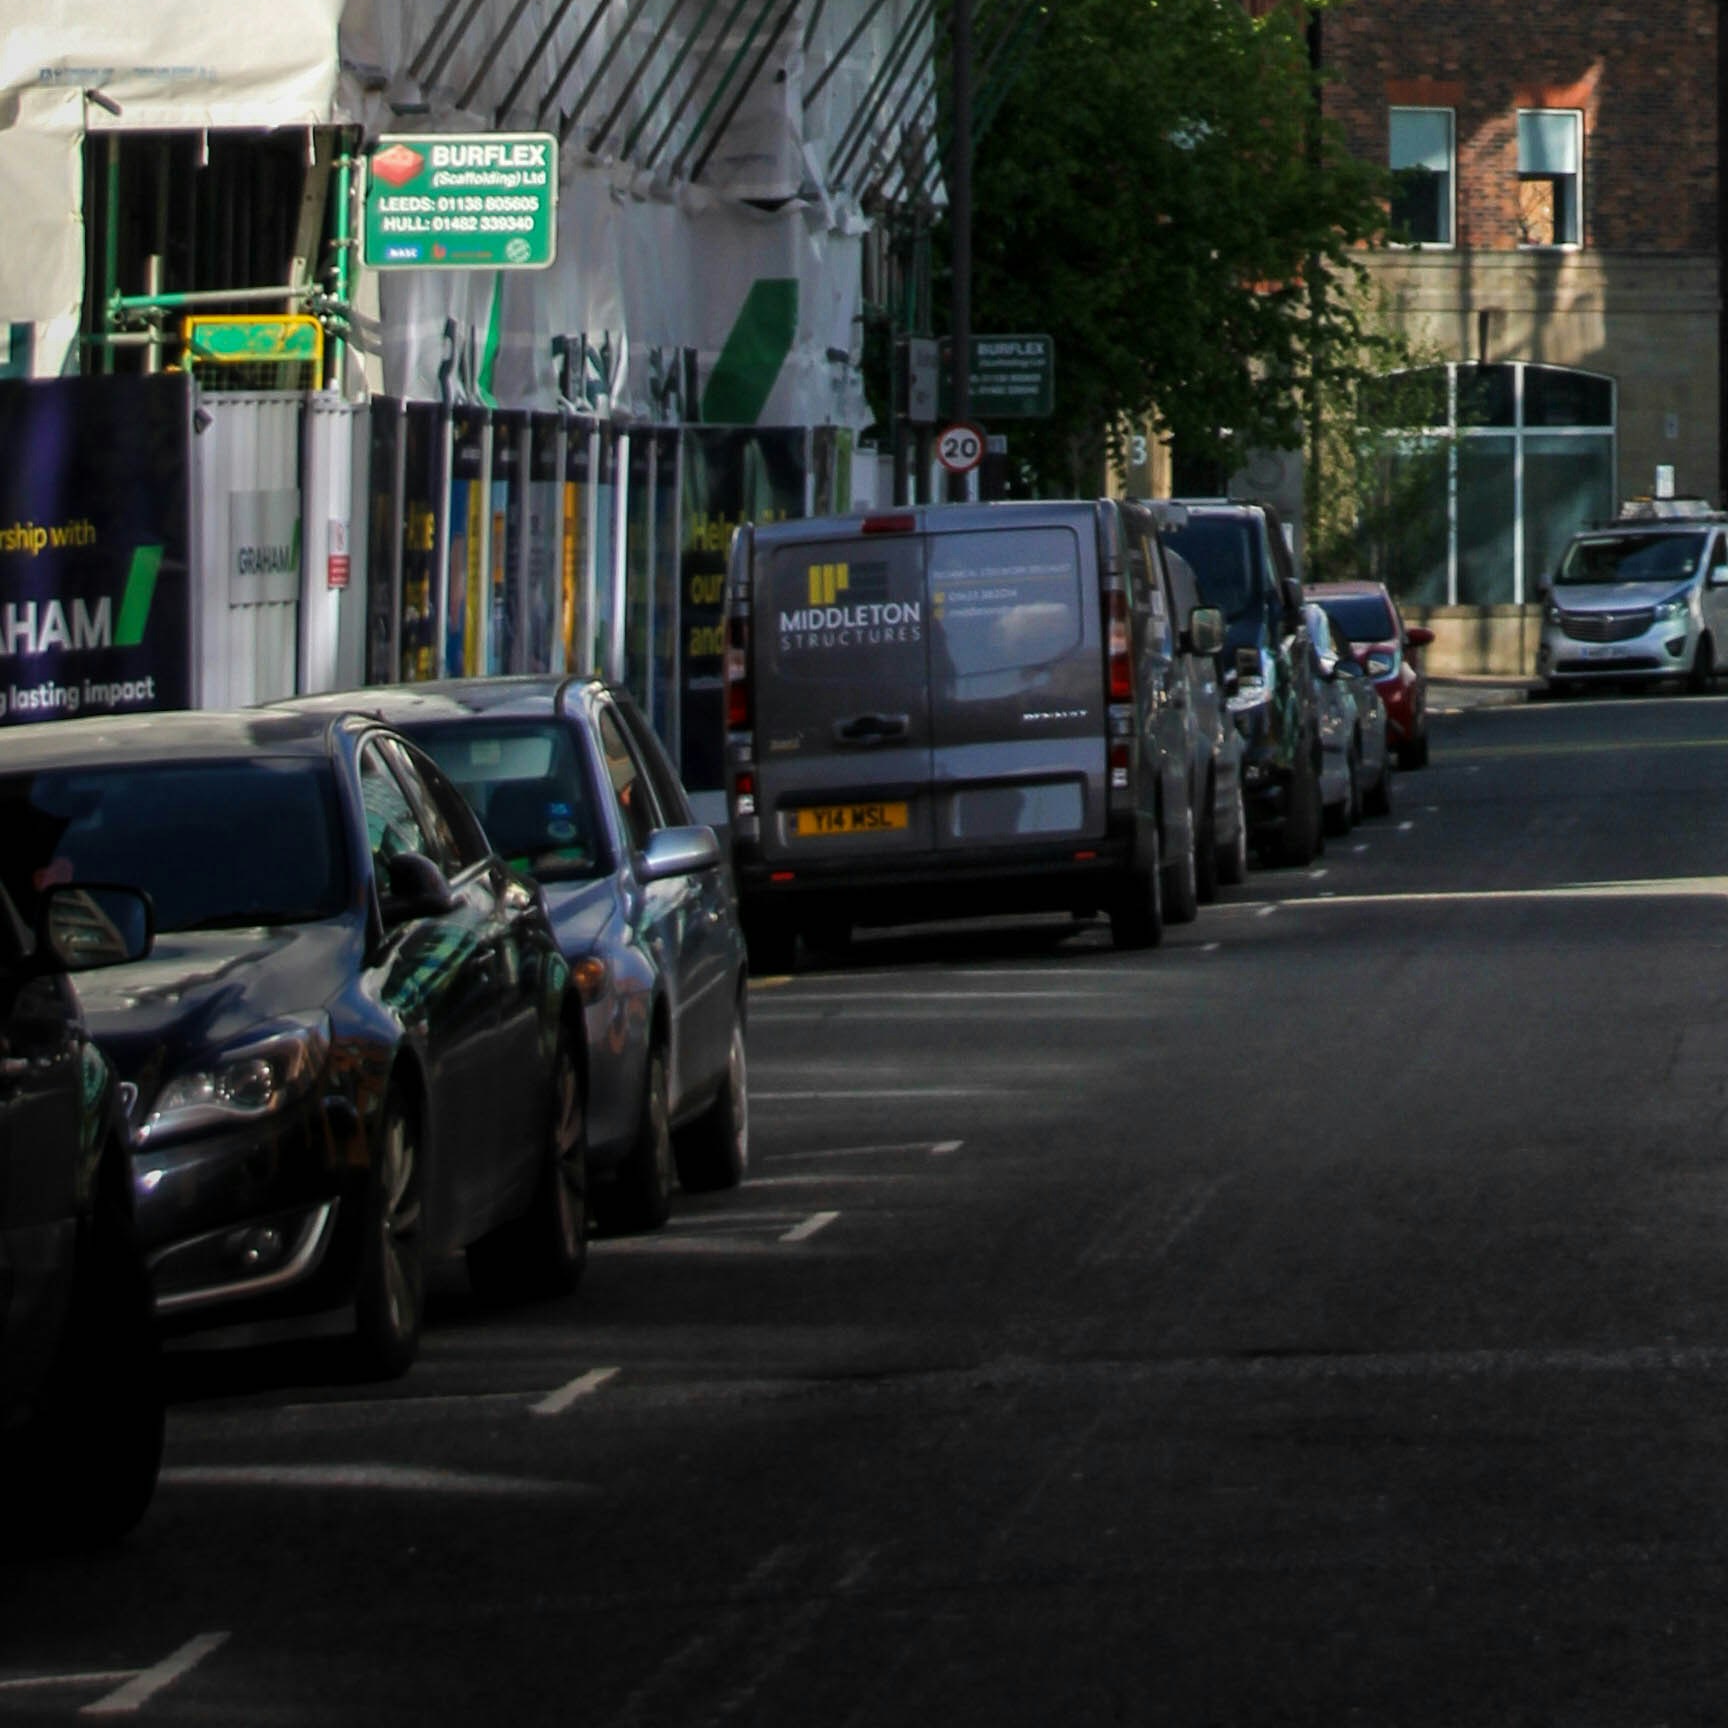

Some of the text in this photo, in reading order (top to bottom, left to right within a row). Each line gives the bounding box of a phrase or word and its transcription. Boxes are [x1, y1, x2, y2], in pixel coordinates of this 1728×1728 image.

[432, 145, 546, 167] BURFLEX
[432, 171, 546, 188] (Scaffolding) Ltd
[379, 197, 435, 212] LEEDS:
[383, 216, 430, 231] HULL:
[944, 438, 978, 458] 20
[1132, 436, 1147, 465] 3
[50, 519, 96, 546] with
[0, 596, 112, 656] HAM
[780, 602, 921, 632] MIDDLETON
[781, 626, 921, 651] STRUCTURES
[10, 681, 81, 711] lasting
[84, 676, 156, 707] impact
